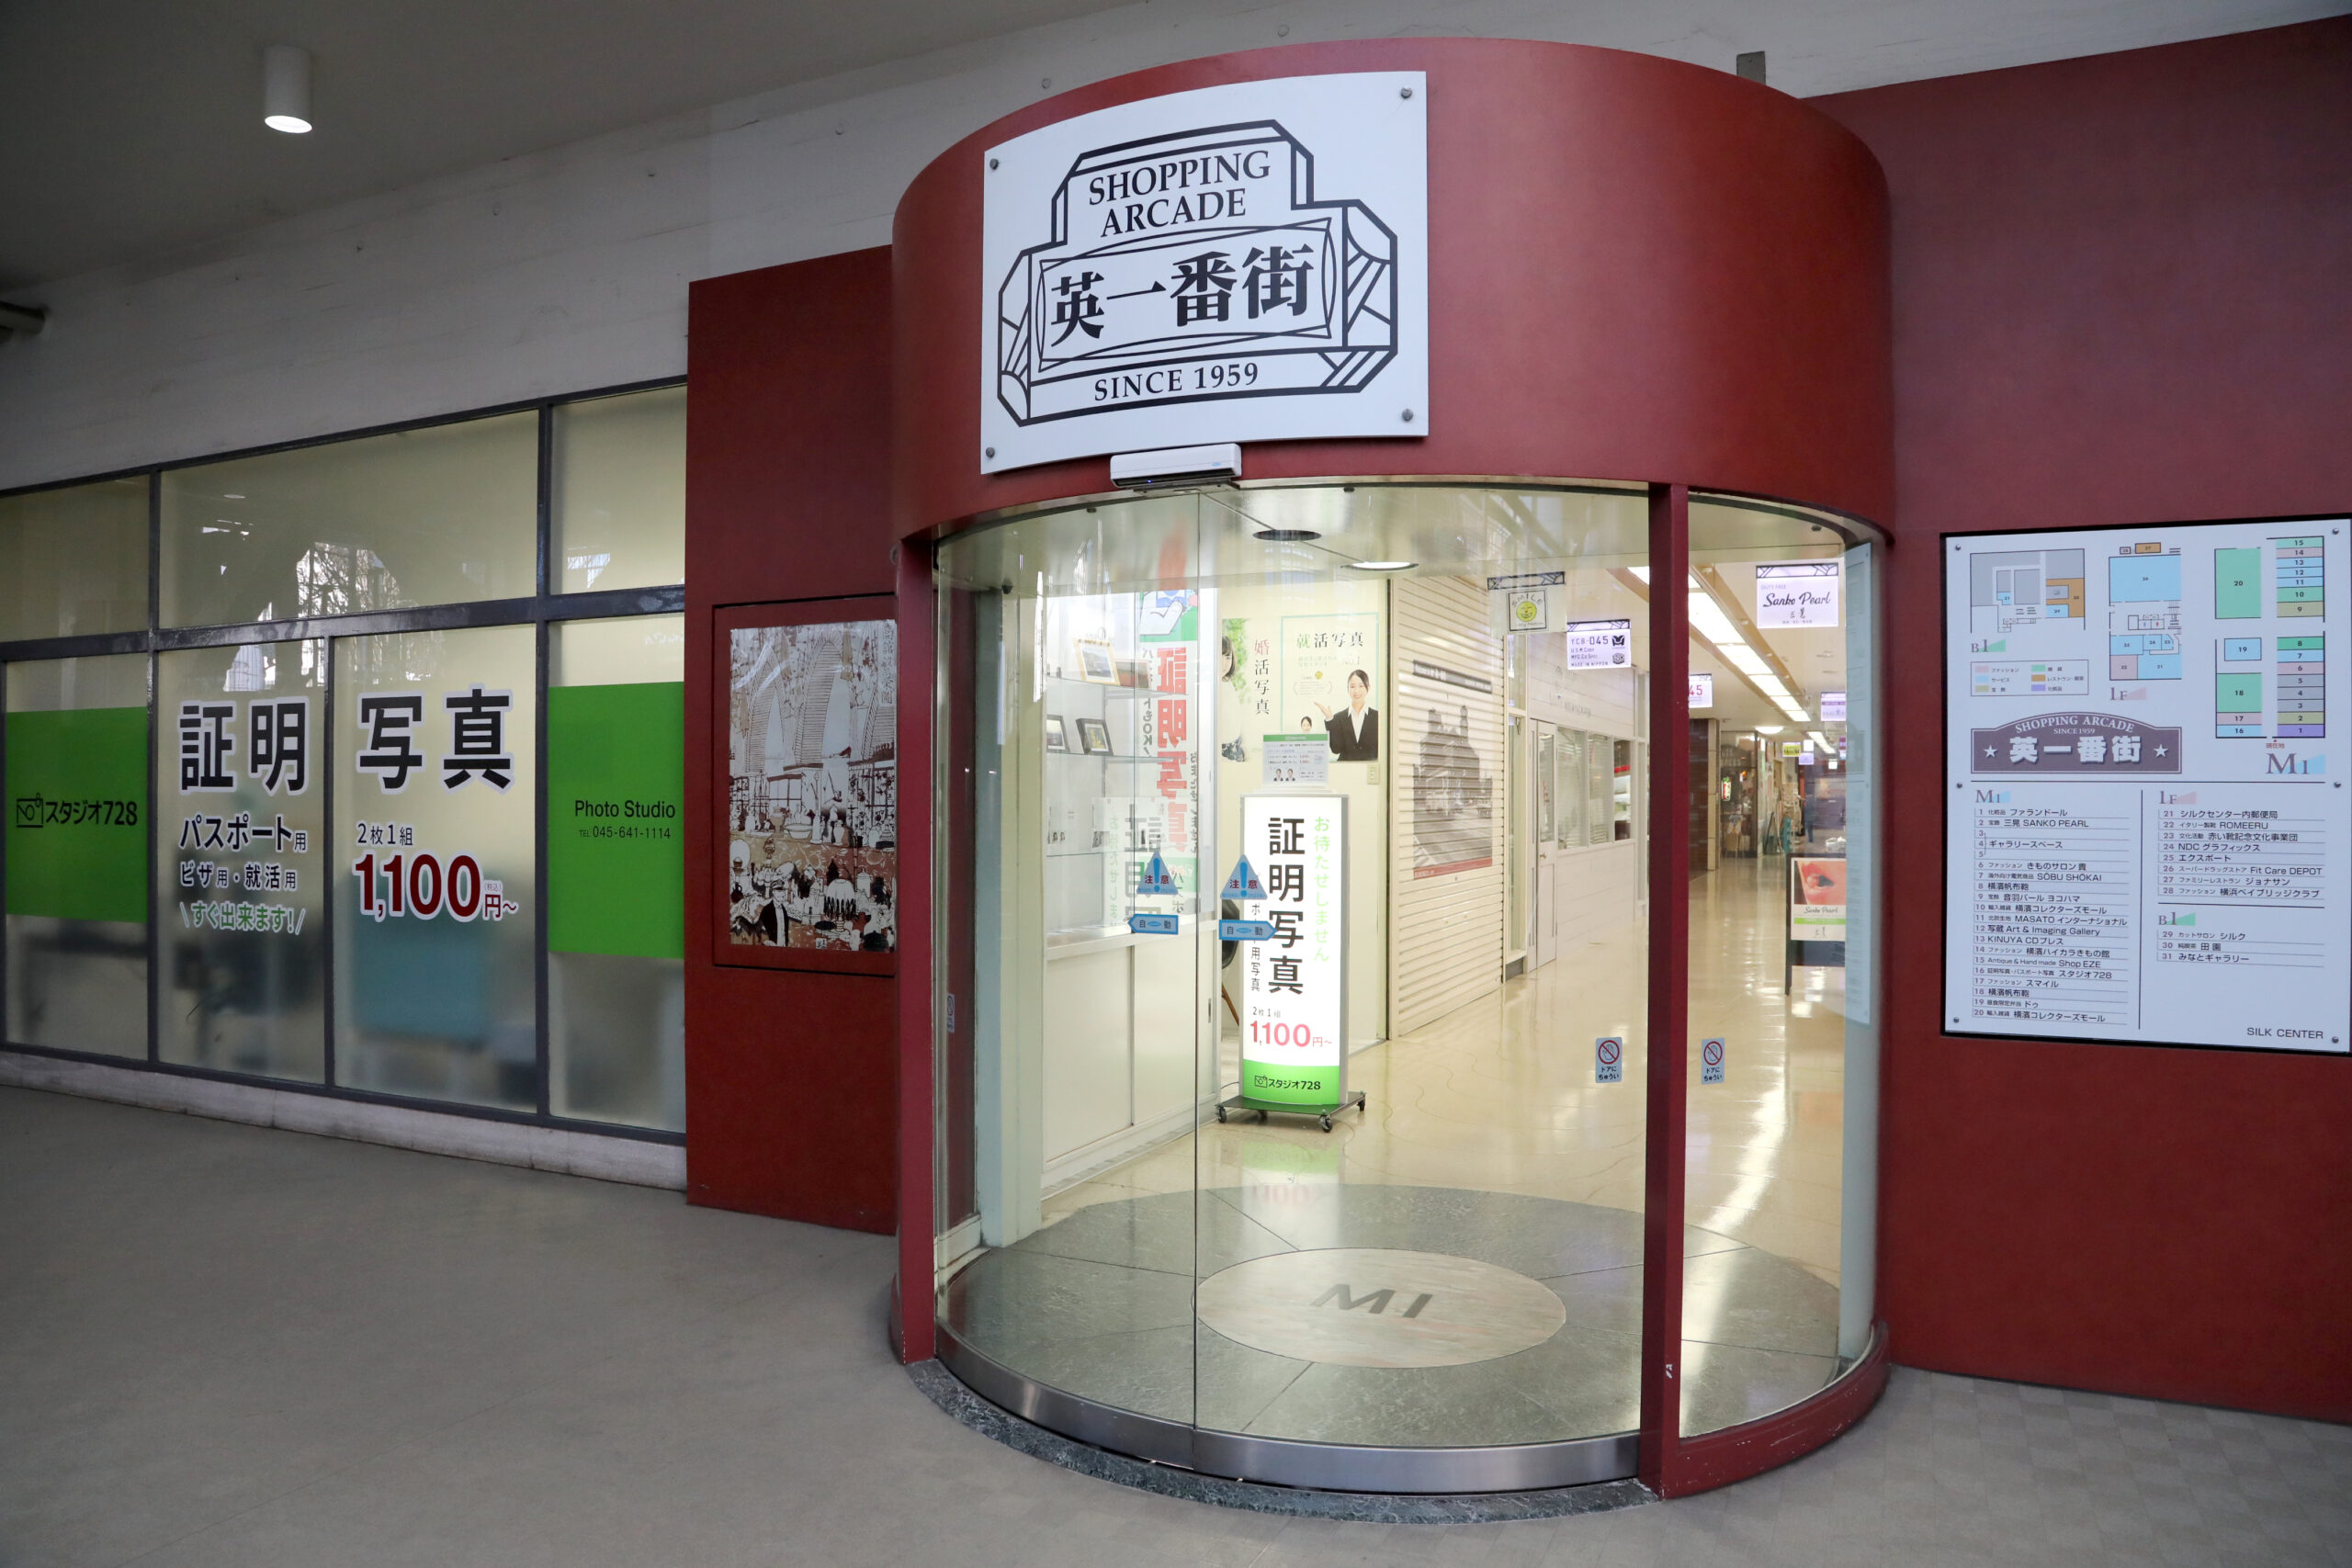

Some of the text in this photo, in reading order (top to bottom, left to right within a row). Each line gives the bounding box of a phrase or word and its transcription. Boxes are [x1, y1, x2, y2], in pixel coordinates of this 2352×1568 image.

[1089, 150, 1271, 206] SHOPPING
[1101, 187, 1246, 237] ARCADE
[1051, 243, 1315, 347] 英一番街
[1094, 363, 1258, 401] SINCE 1959
[1763, 592, 1831, 607] Sanko Pearl
[1297, 632, 1363, 649] 就活写真
[1255, 639, 1270, 715] 婚活写真
[2015, 716, 2135, 734] SHOPPING ARCADE
[2009, 736, 2142, 764] 英一番街
[46, 800, 138, 826] スタジオ728
[575, 800, 675, 818] Photo Studio
[2180, 810, 2278, 819] シルクセンター内郵便局
[180, 813, 307, 851] パスポート用
[357, 823, 413, 845] 2枚1組
[593, 826, 671, 839] 045-641-1114
[2208, 832, 2298, 841] 赤い靴記念文化事業団
[1989, 840, 2063, 849] ギャラリースペース
[2251, 866, 2262, 874] Fit
[1314, 816, 1330, 962] お待たせしません
[1268, 817, 1305, 995] 証明写真
[2057, 917, 2128, 926] インターナショナル
[2032, 926, 2066, 934] Imaging
[2070, 928, 2100, 936] Gallery
[2059, 960, 2081, 968] Shop
[2178, 953, 2249, 963] みなとギャラリー
[2059, 969, 2112, 979] スタジオ728
[2026, 979, 2059, 987] スマイル
[2247, 1027, 2324, 1039] SILK CENTER
[1269, 1078, 1321, 1089] スタジオ728
